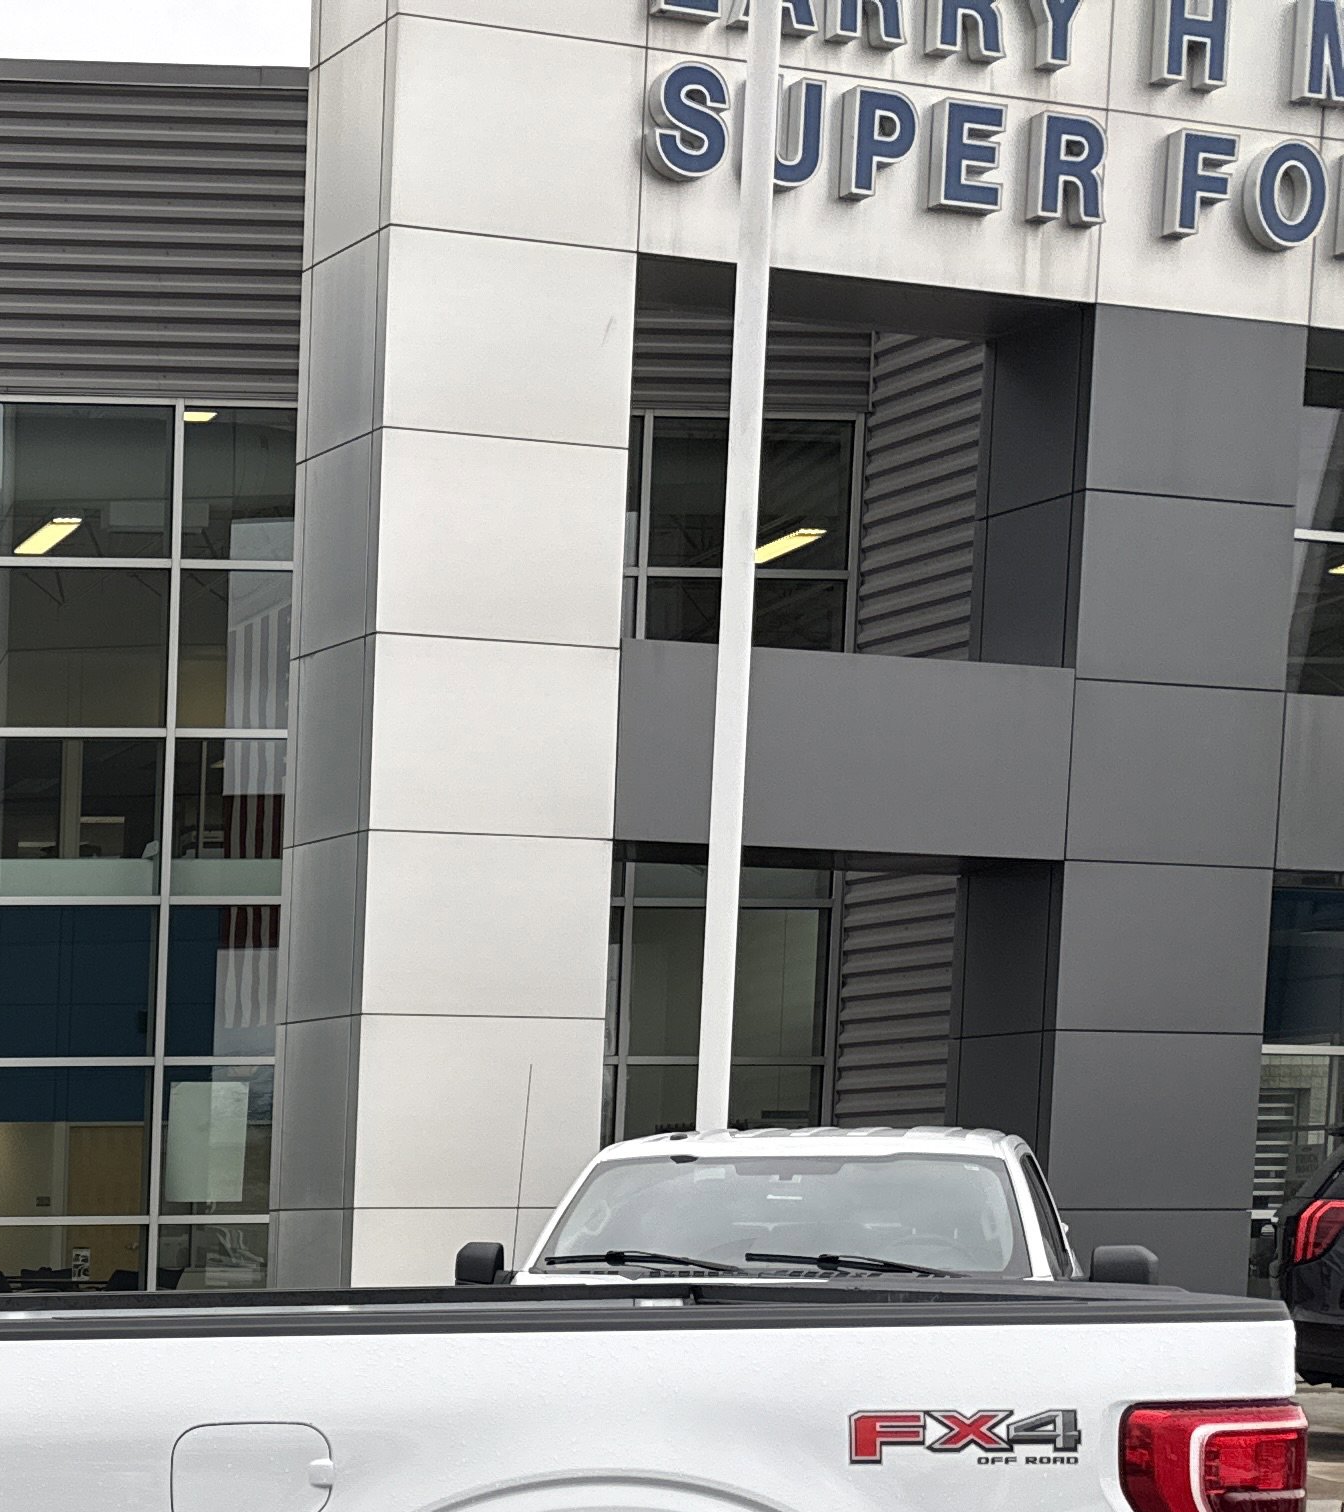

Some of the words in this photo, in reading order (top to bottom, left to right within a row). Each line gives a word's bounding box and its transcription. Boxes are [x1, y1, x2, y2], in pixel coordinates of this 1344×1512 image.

[649, 0, 1086, 71] RRY
[1151, 0, 1234, 92] H
[646, 60, 1109, 228] SUPER
[1162, 124, 1344, 257] FO
[849, 1409, 1082, 1465] FX4
[977, 1456, 1018, 1465] OFF
[1024, 1456, 1079, 1465] ROAD
